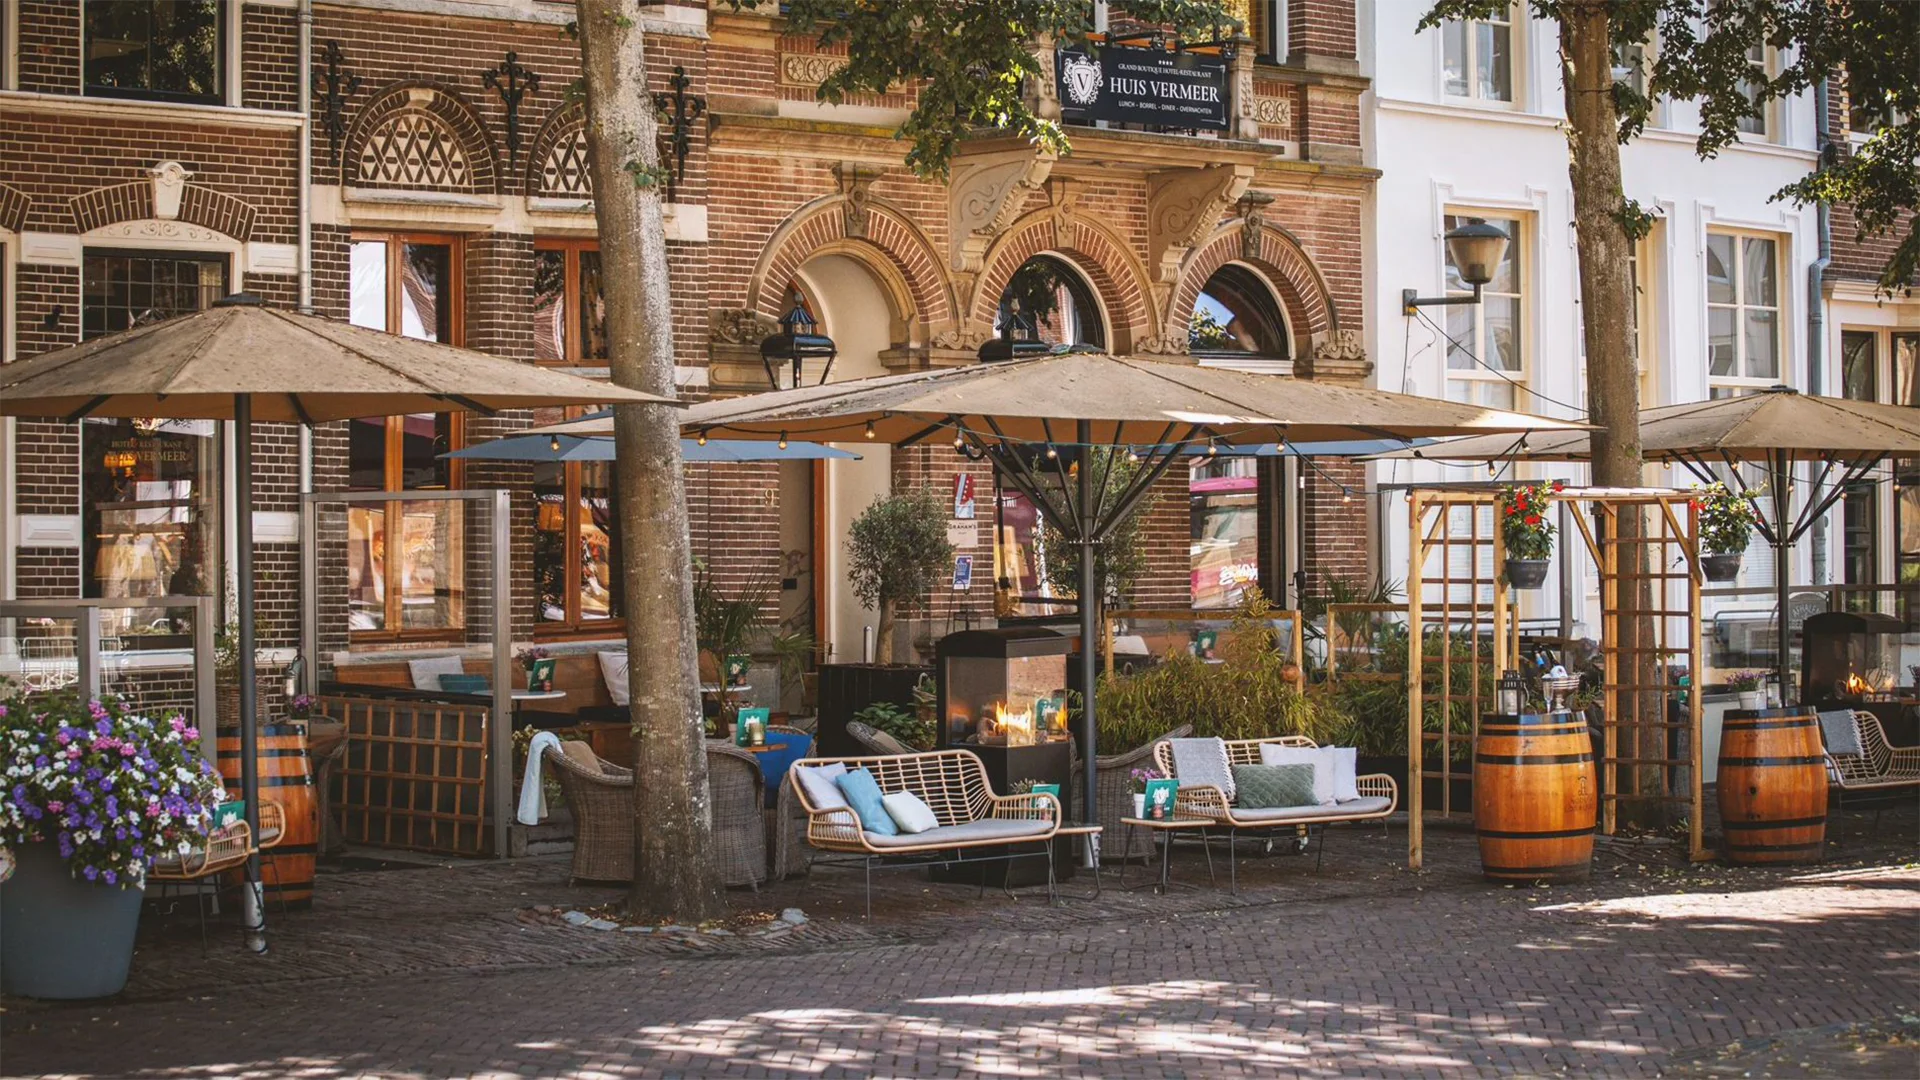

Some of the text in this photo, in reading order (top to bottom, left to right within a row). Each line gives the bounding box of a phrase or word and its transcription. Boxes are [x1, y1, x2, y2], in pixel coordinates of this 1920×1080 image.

[1117, 63, 1137, 71] GRAND
[1138, 65, 1162, 75] BOUTIQUE
[1076, 73, 1089, 90] V
[1110, 77, 1220, 103] HUIS VERMEER
[1118, 100, 1212, 114] LUNCH BORREL DINER OVERNACHTEN
[136, 451, 186, 462] VERMEER
